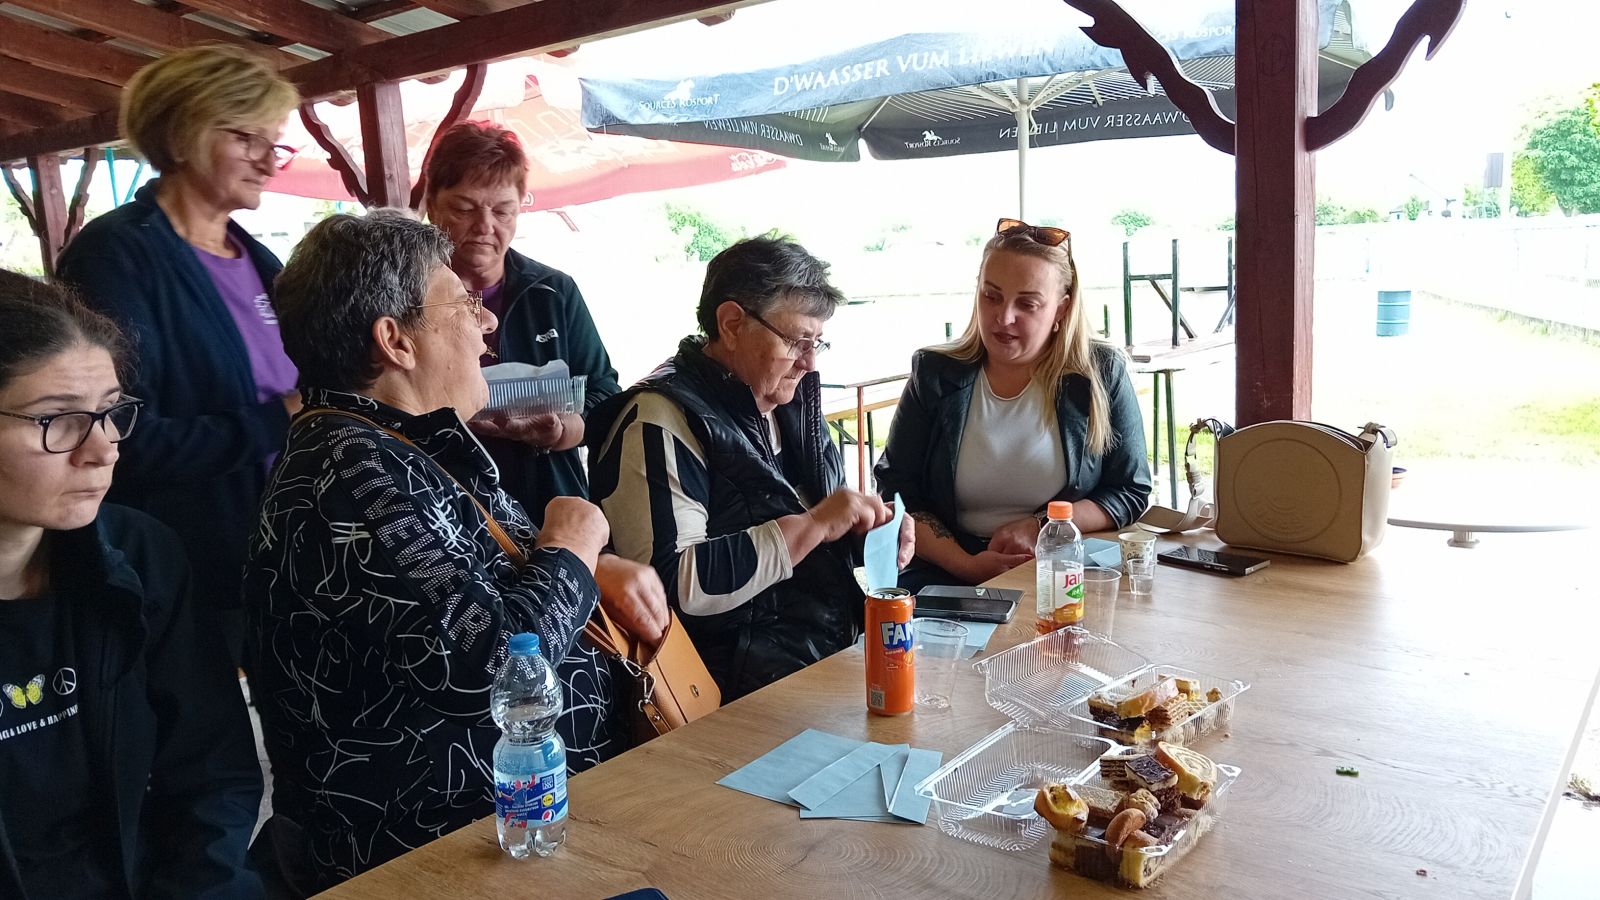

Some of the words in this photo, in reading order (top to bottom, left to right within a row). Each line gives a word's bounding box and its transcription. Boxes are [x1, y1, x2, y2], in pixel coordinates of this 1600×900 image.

[773, 58, 891, 96] D'WAASSER
[897, 50, 950, 73] VUM
[326, 426, 492, 652] ACTIVEWEAR
[16, 721, 37, 735] LOVE
[40, 719, 46, 727] &
